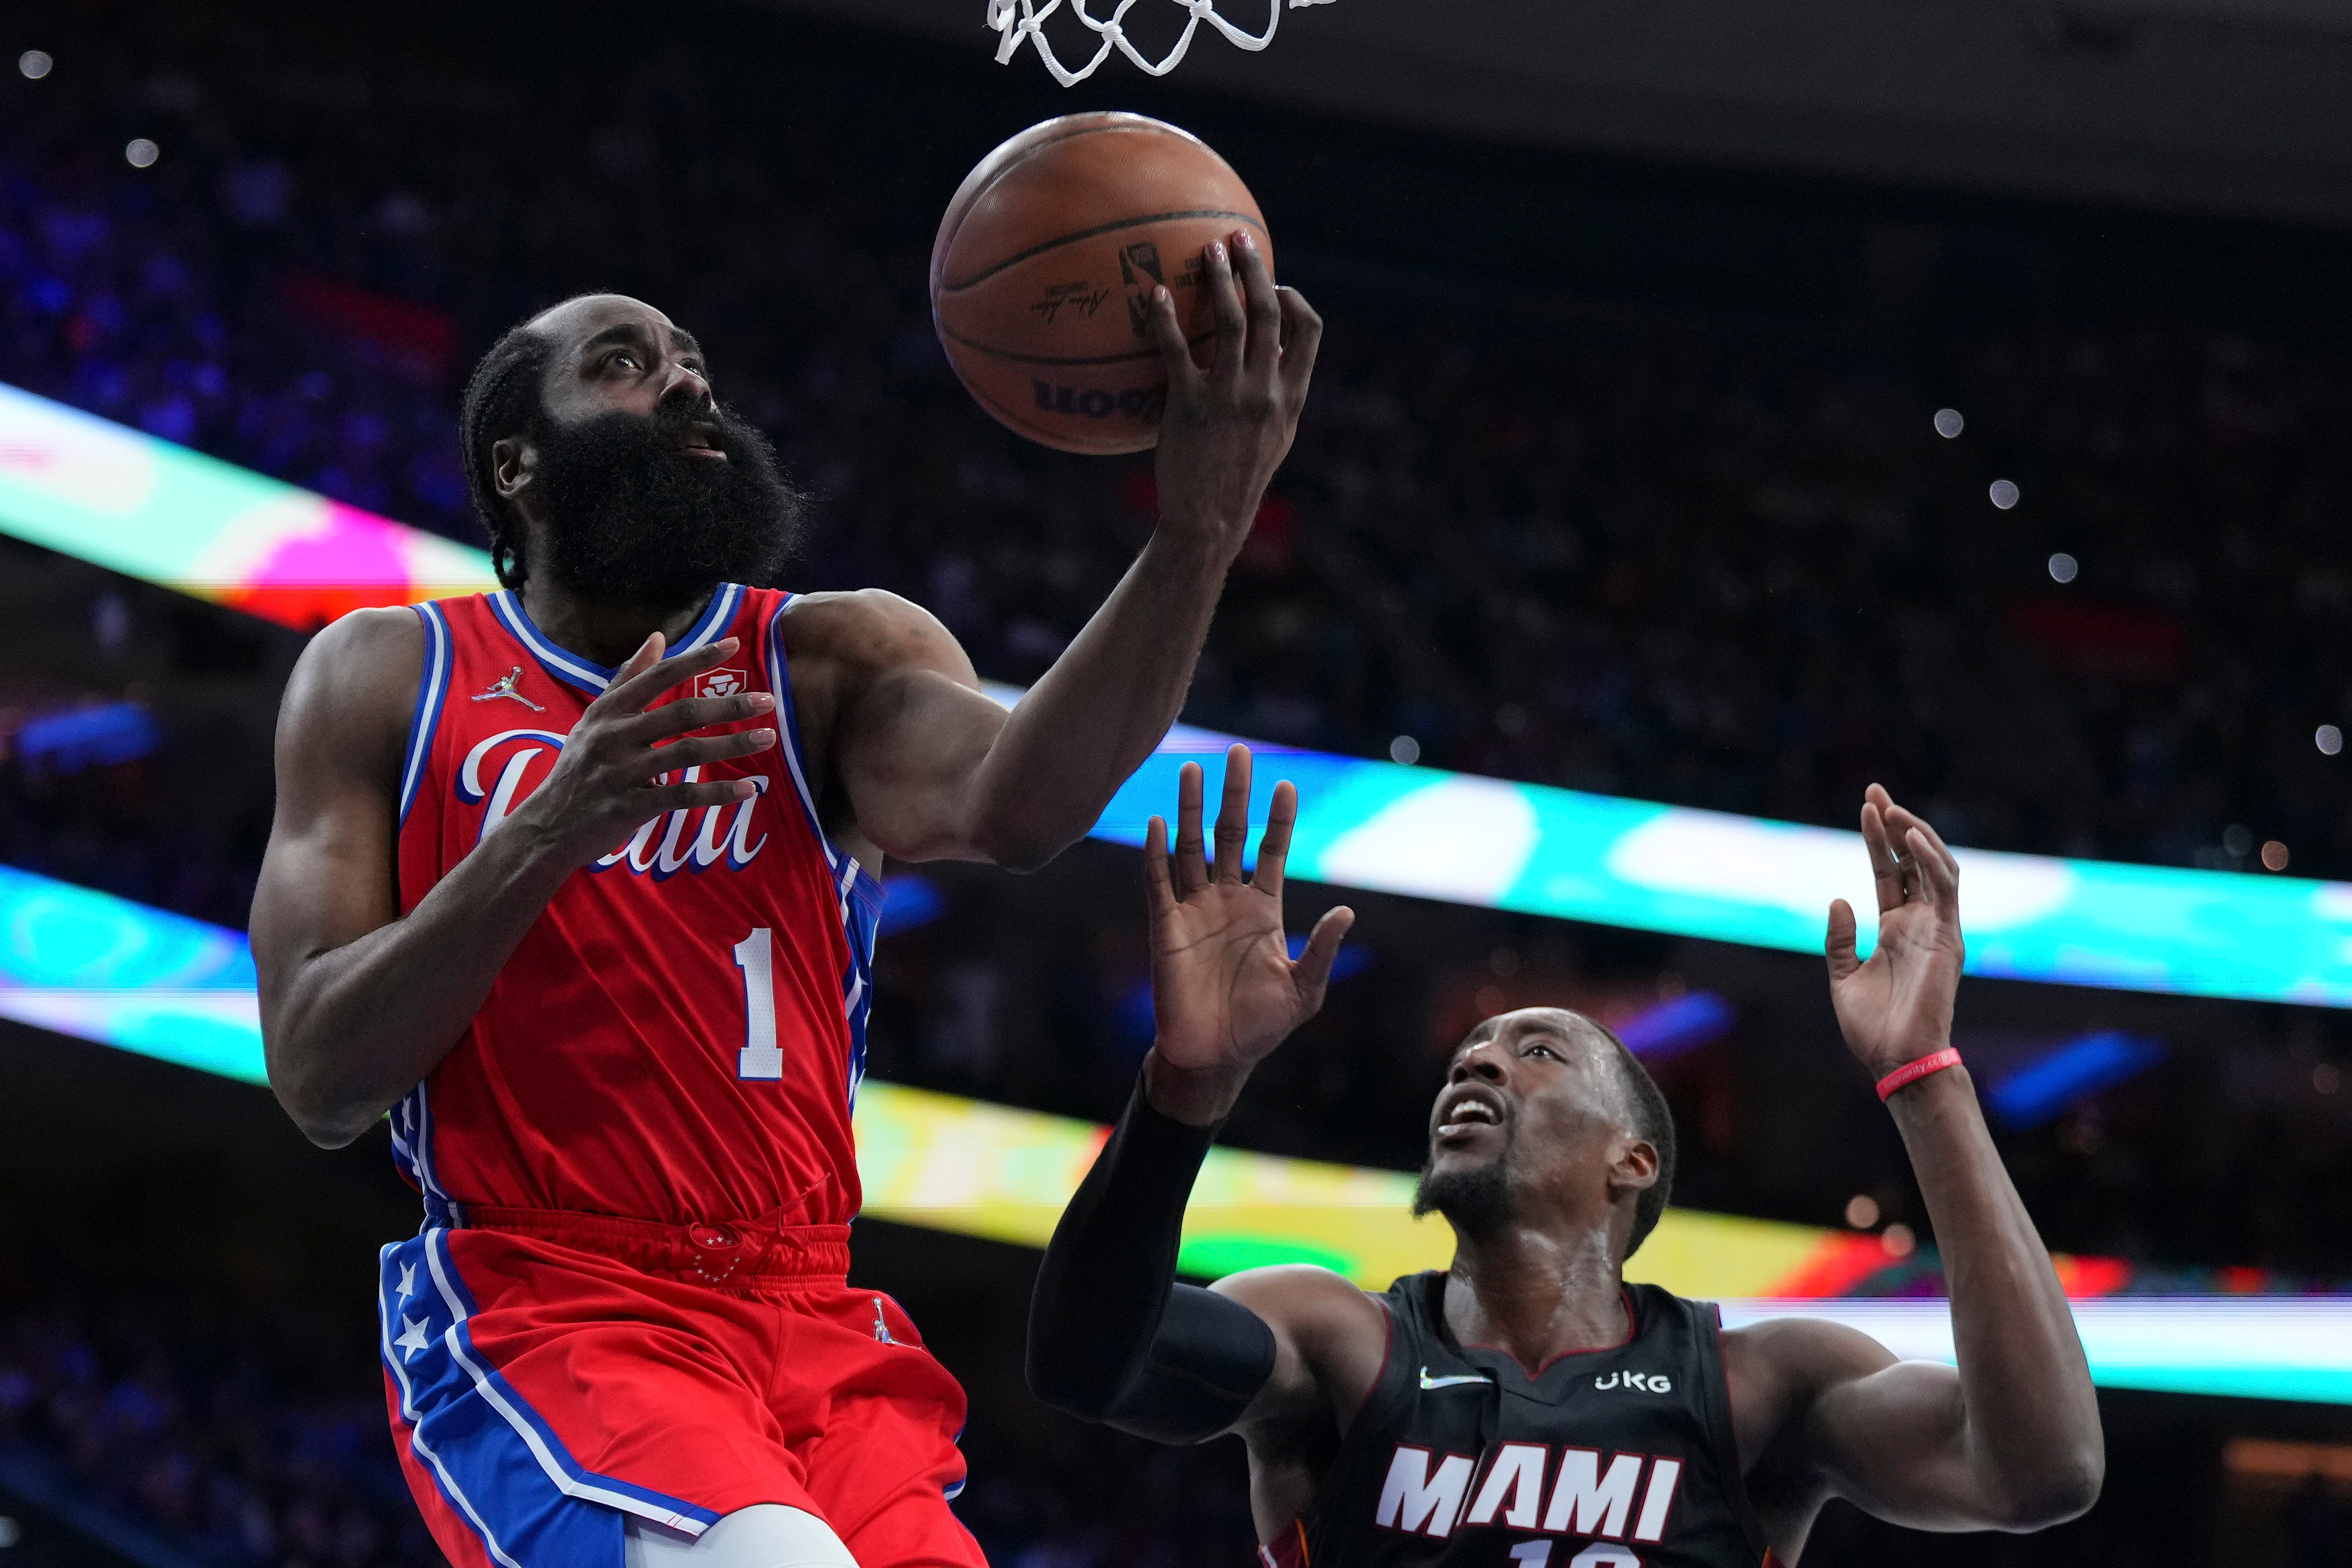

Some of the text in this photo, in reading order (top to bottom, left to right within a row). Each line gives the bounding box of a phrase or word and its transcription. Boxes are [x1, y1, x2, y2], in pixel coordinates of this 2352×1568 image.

[734, 928, 783, 1081] 1
[1595, 1370, 1671, 1394] UKG
[1374, 1441, 1684, 1544] MAMI
